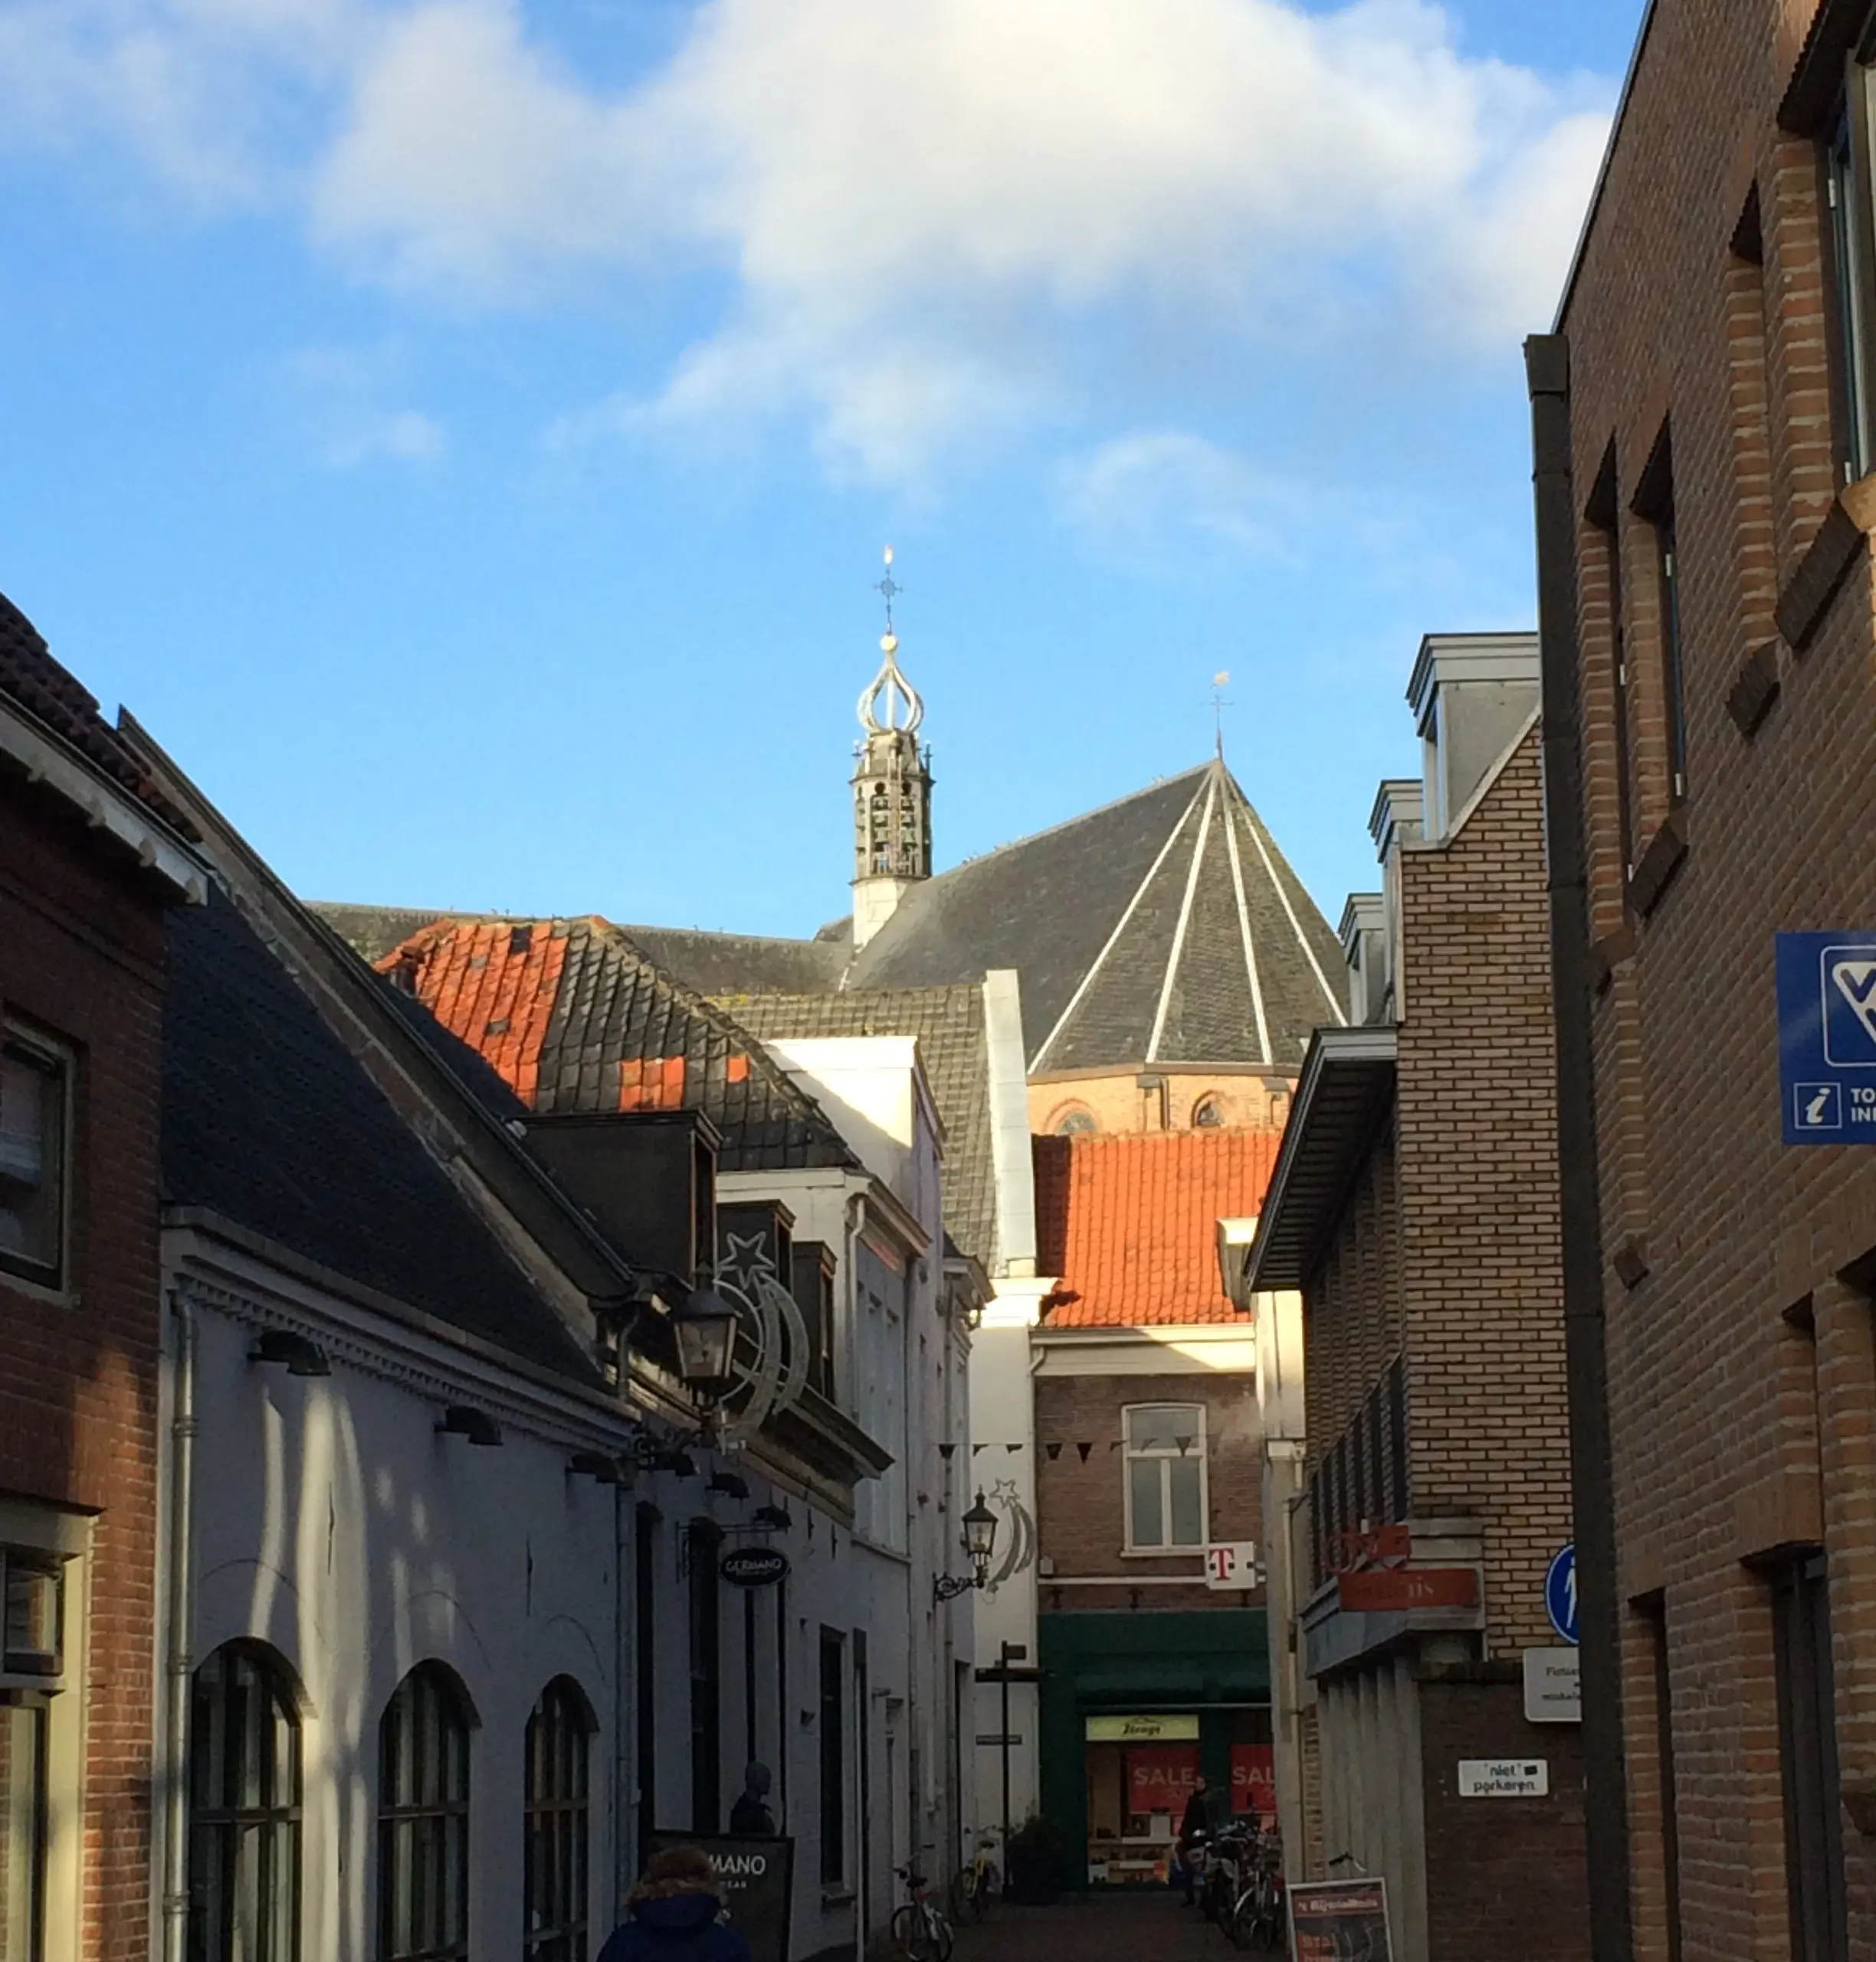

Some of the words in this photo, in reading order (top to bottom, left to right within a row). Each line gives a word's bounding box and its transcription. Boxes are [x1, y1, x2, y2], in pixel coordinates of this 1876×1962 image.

[725, 1558, 782, 1572] GERMANO
[1133, 1767, 1195, 1786] SALE
[1490, 1764, 1515, 1777] niet
[1474, 1780, 1535, 1793] parkeren
